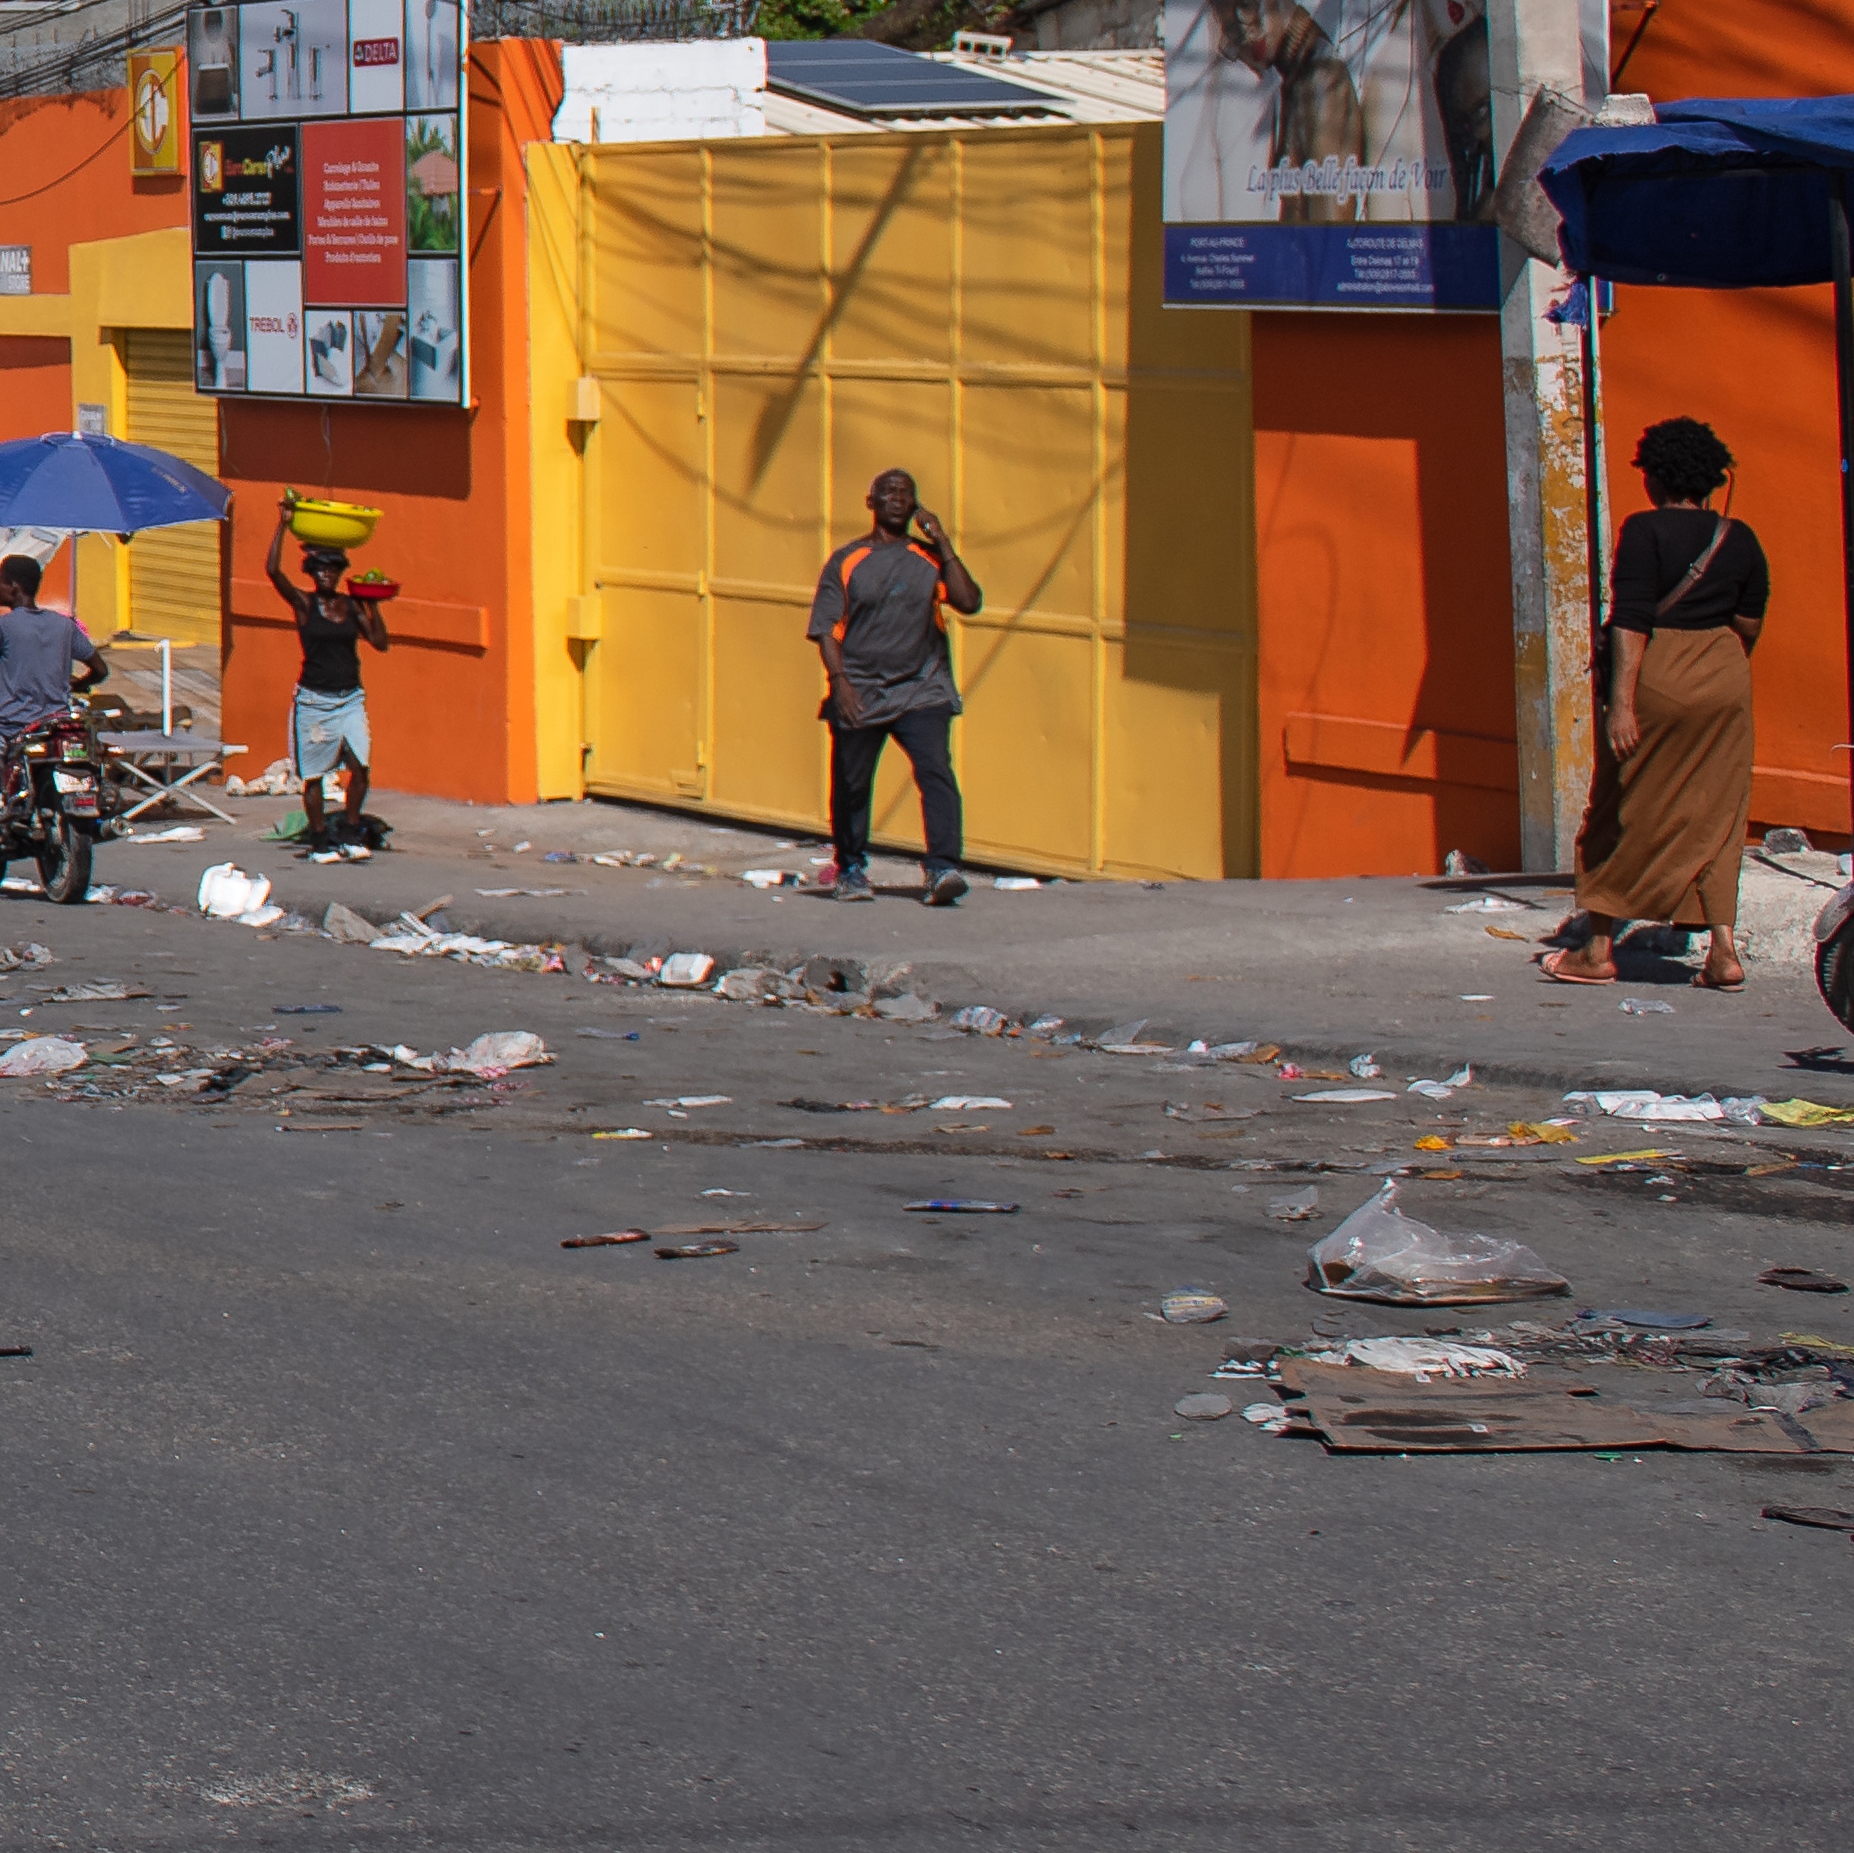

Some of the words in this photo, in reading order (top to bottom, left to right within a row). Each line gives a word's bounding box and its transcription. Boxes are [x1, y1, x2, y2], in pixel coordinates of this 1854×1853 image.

[364, 41, 397, 62] DELTA
[1246, 164, 1265, 193] La
[1267, 158, 1301, 201] plus
[1303, 156, 1339, 192] Belle
[1338, 155, 1384, 203] façon
[1389, 158, 1407, 191] de
[1410, 160, 1448, 191] Voir
